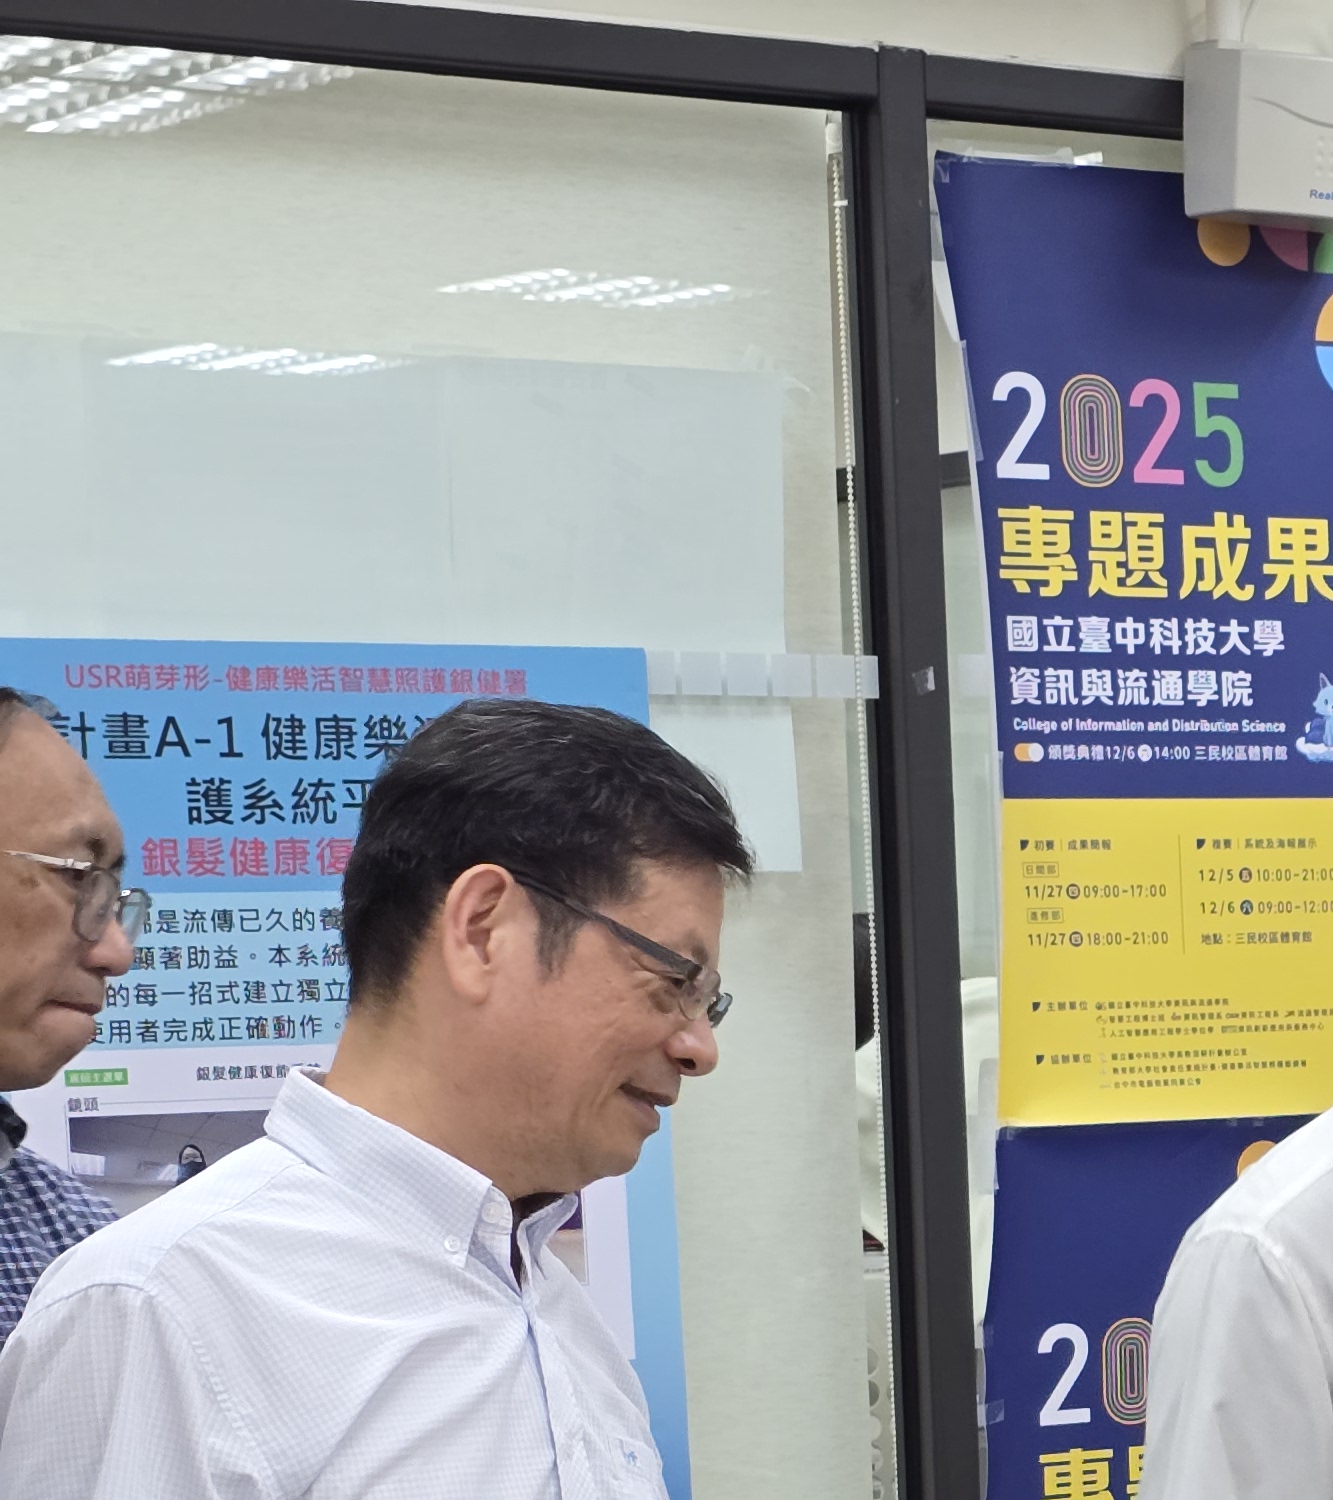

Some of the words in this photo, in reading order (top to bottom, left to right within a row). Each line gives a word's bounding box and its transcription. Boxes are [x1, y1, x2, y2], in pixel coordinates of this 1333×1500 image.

[991, 371, 1244, 488] 2025
[1006, 615, 1286, 656] 國立臺中科技大學
[1009, 667, 1254, 707] 資訊與流通學院
[260, 712, 437, 761] 健康樂
[1013, 717, 1058, 734] College
[1061, 718, 1074, 732] of
[1076, 718, 1145, 732] Information
[1148, 718, 1169, 732] and
[1172, 718, 1239, 732] Distribution
[1242, 719, 1287, 733] Science
